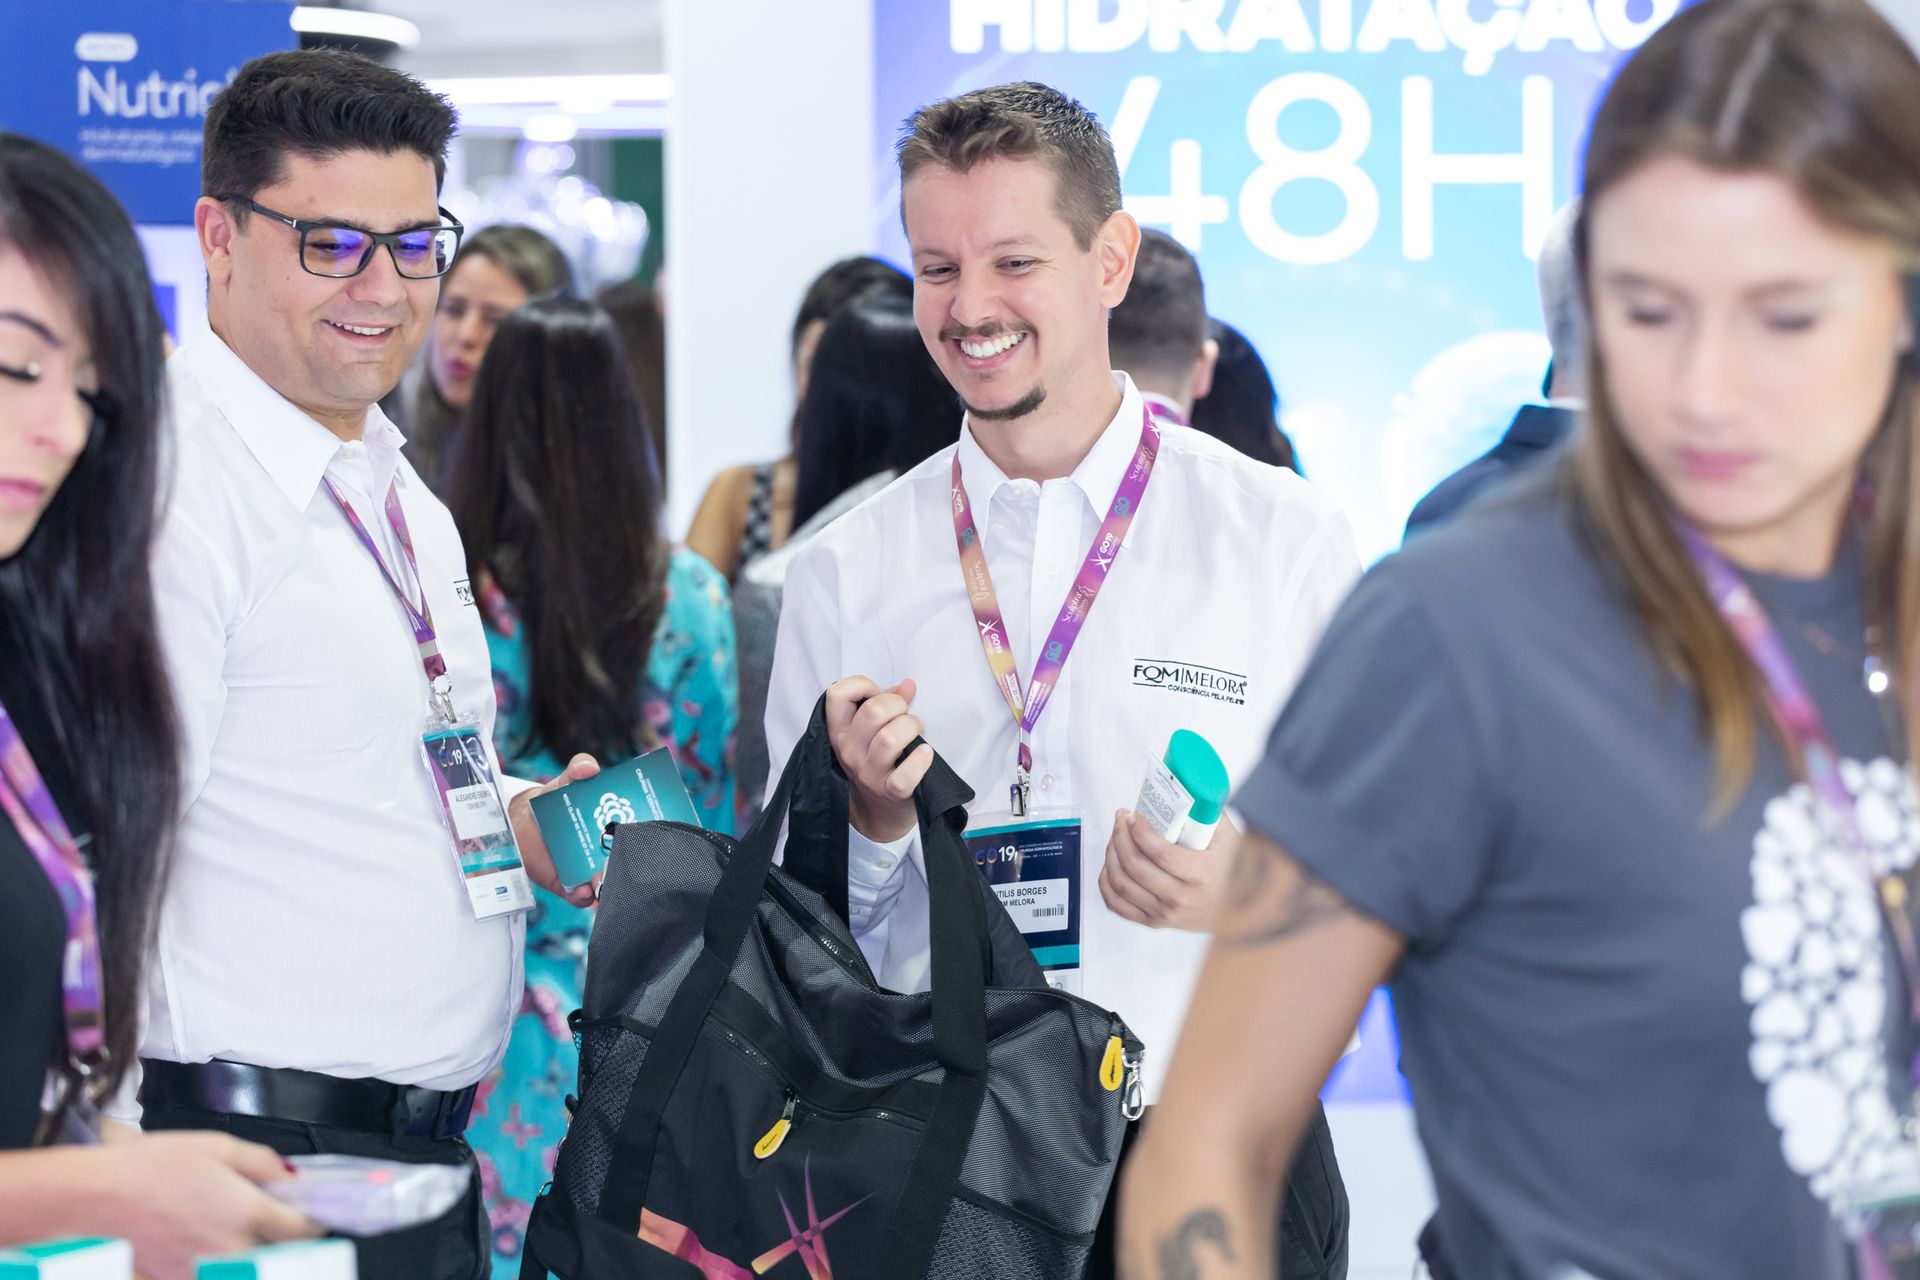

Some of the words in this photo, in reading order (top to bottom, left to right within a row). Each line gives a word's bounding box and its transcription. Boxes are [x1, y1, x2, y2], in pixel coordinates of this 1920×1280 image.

[78, 66, 239, 119] Nutri
[1108, 72, 1554, 265] 48H
[1009, 898, 1036, 907] MELORA
[1016, 886, 1047, 897] BORGES
